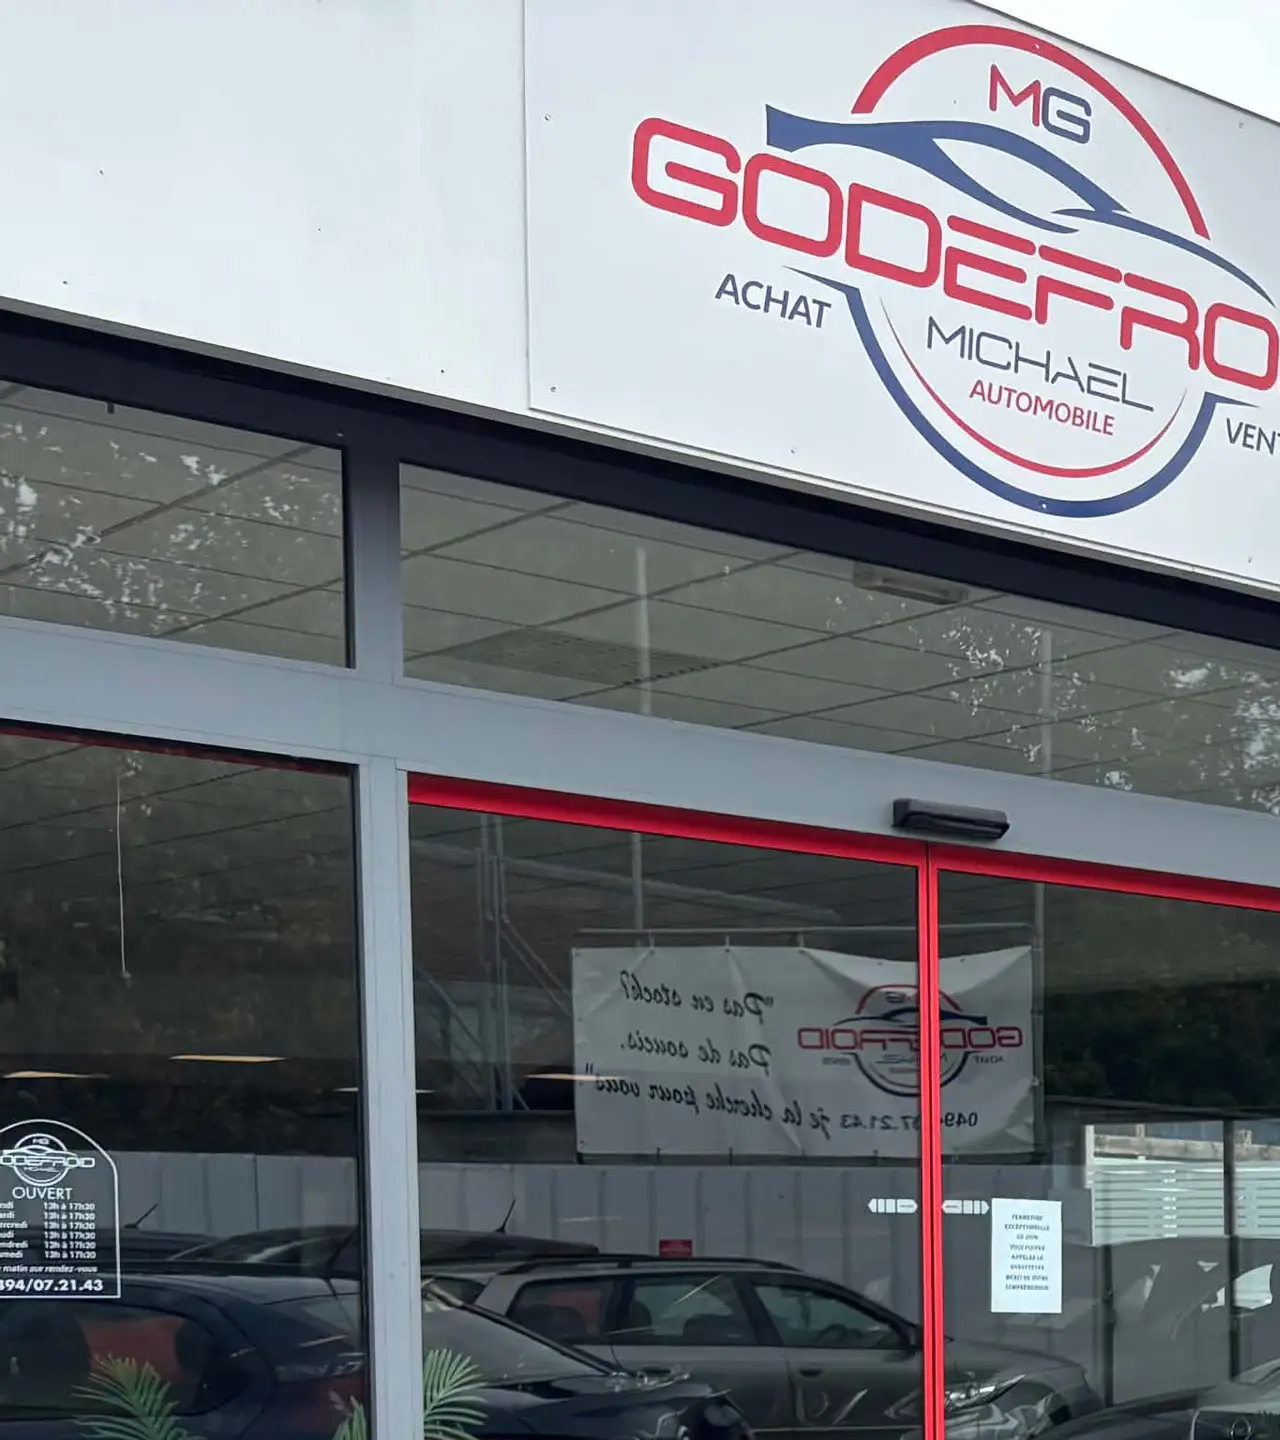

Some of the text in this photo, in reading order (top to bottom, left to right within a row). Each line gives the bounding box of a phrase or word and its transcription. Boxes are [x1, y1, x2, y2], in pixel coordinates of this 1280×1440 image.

[989, 64, 1092, 144] MG
[715, 273, 832, 329] ACHAT
[927, 315, 1154, 412] MICHAEL
[969, 380, 1114, 437] AUTOMOBILE
[12, 1186, 73, 1200] OUVERT
